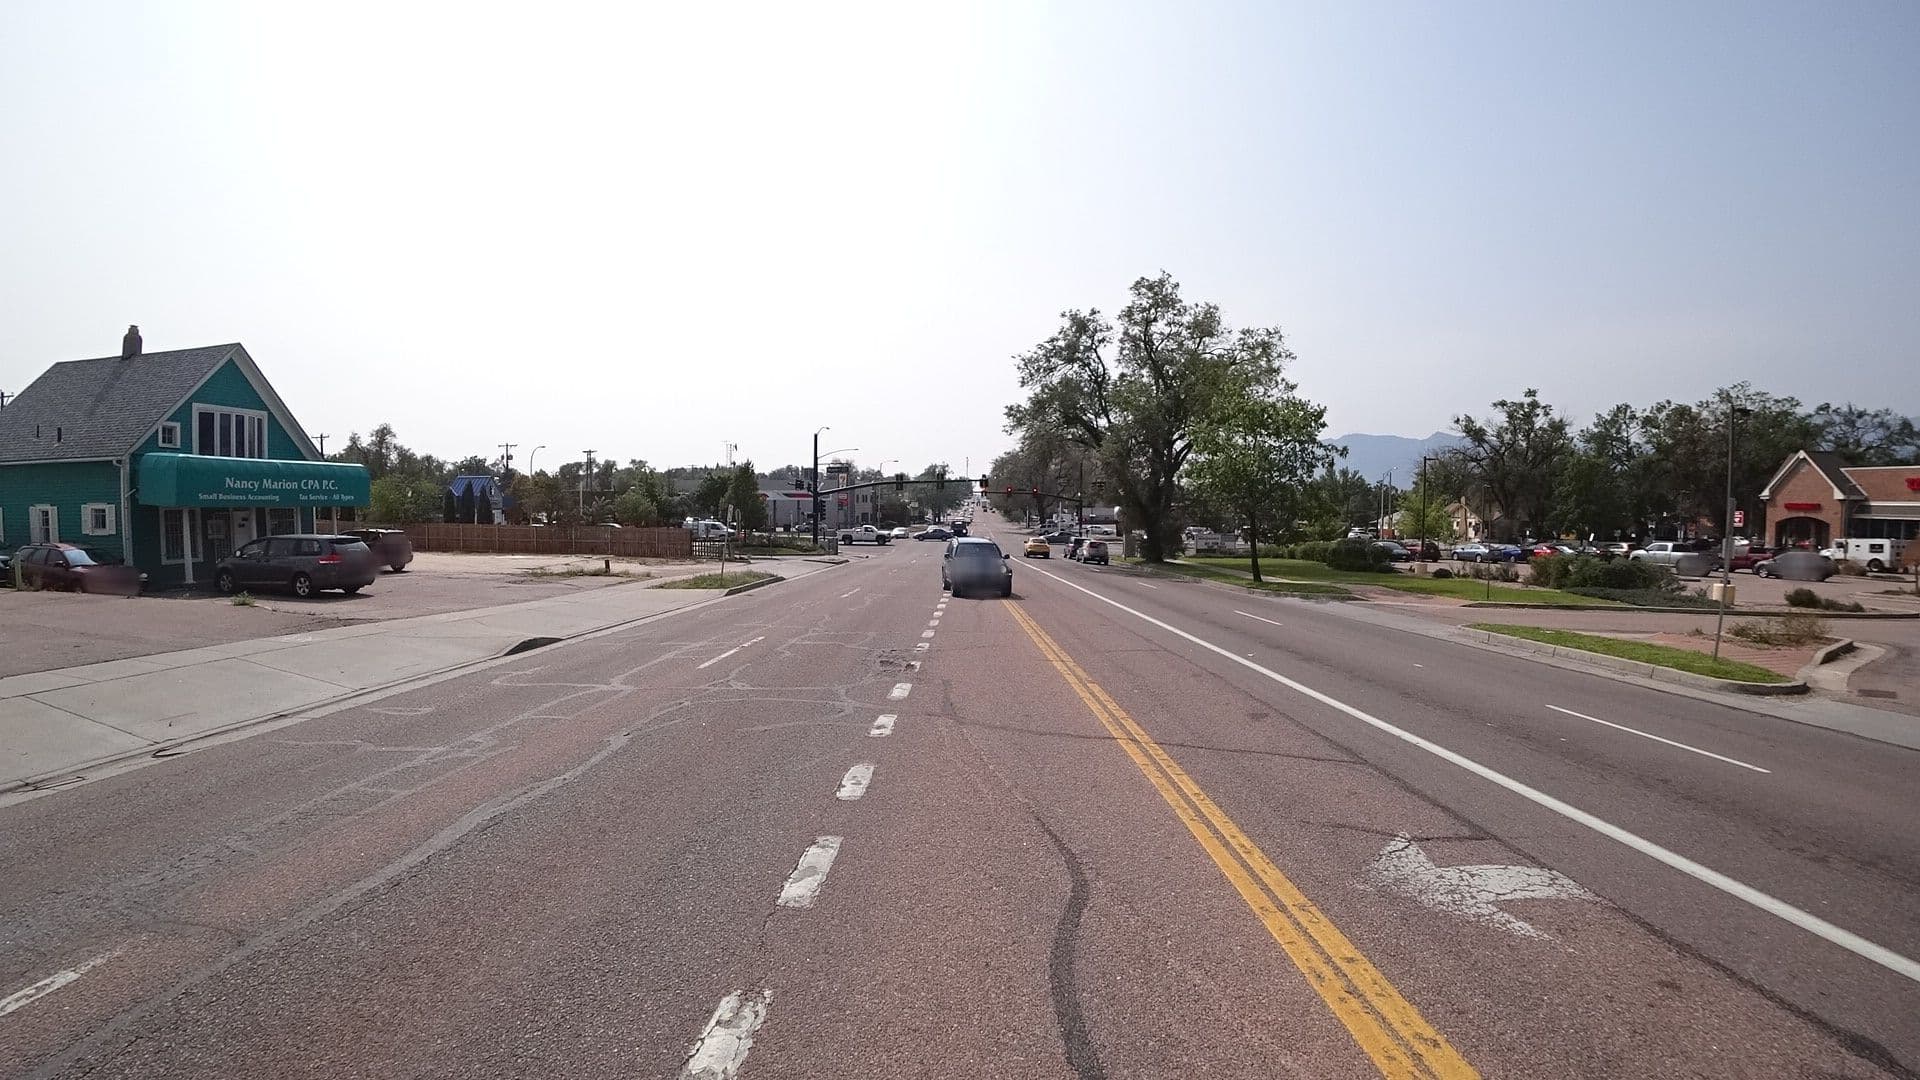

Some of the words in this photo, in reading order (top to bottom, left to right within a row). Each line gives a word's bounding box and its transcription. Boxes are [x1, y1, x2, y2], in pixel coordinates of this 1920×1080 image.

[225, 477, 260, 491] Nancy
[262, 478, 298, 490] Marion
[301, 479, 320, 490] CPA
[322, 480, 338, 490] P.C.
